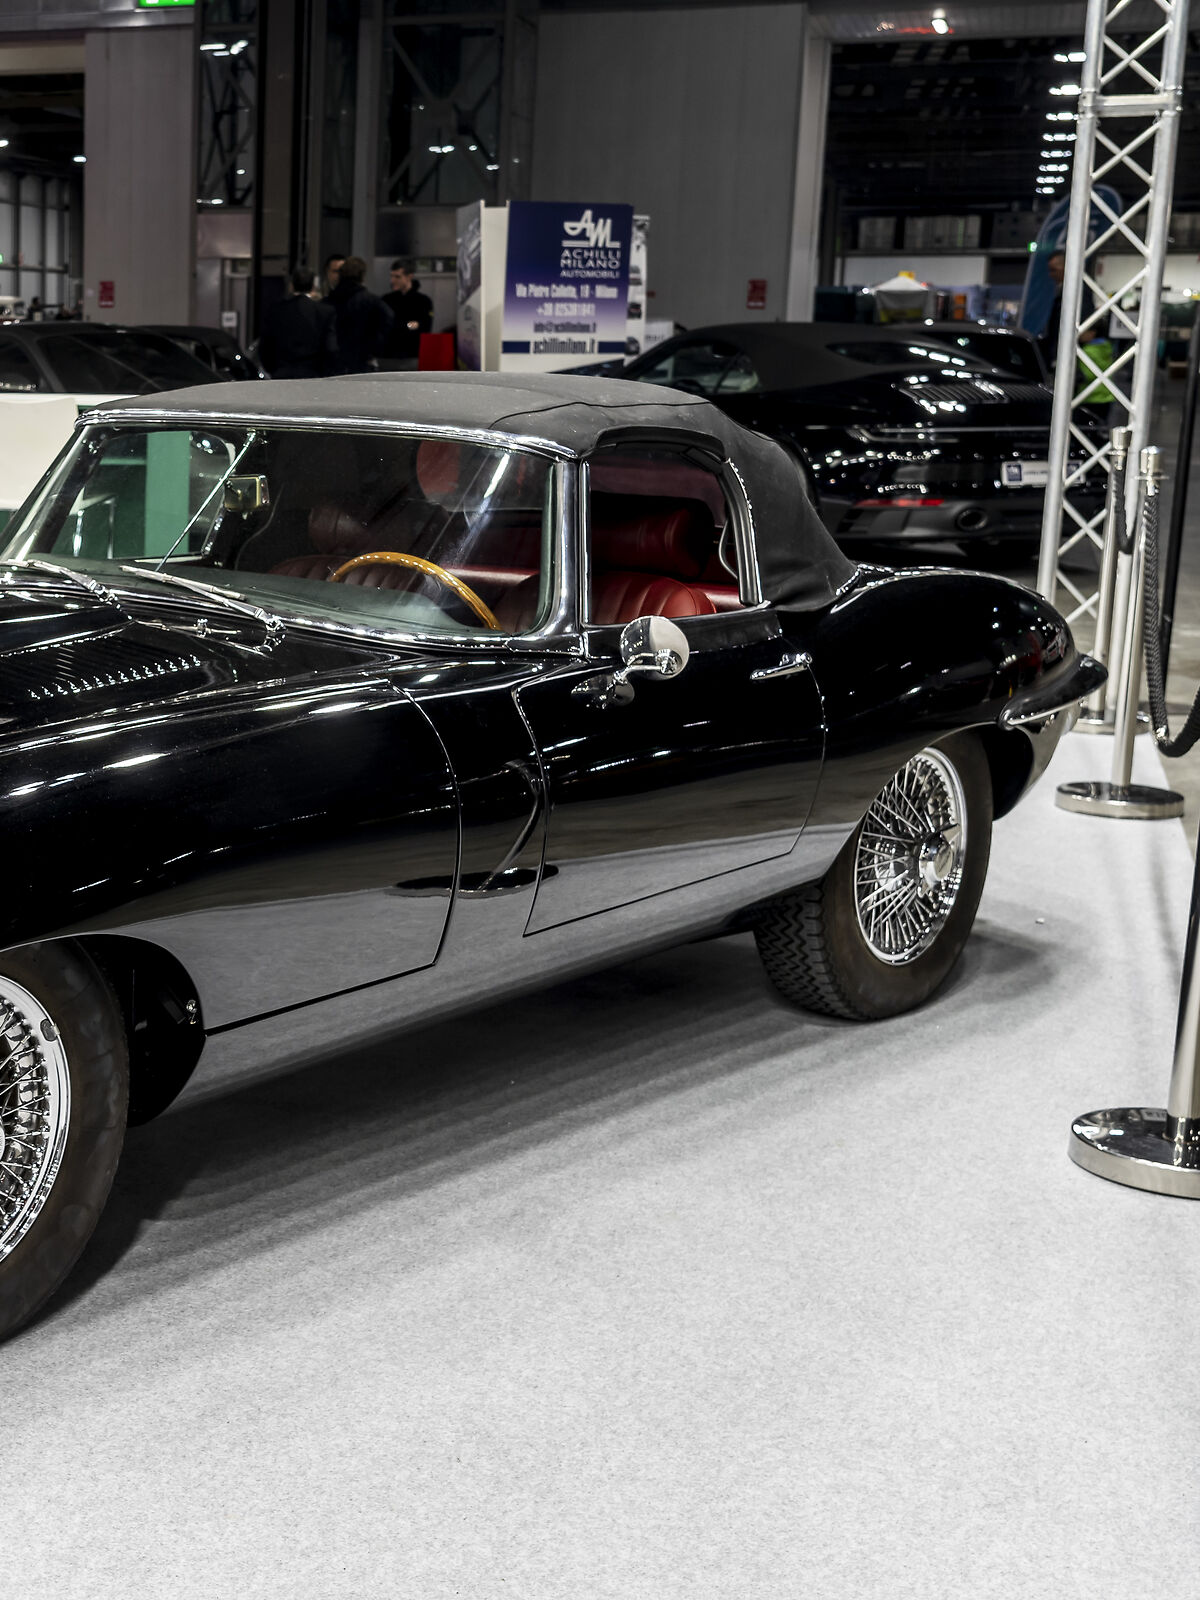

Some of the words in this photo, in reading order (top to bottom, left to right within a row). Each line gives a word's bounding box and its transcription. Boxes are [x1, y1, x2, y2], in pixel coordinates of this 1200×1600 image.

[561, 249, 621, 259] ACHILLI
[560, 259, 620, 269] MILANO
[560, 269, 620, 279] AUTOMOBILI
